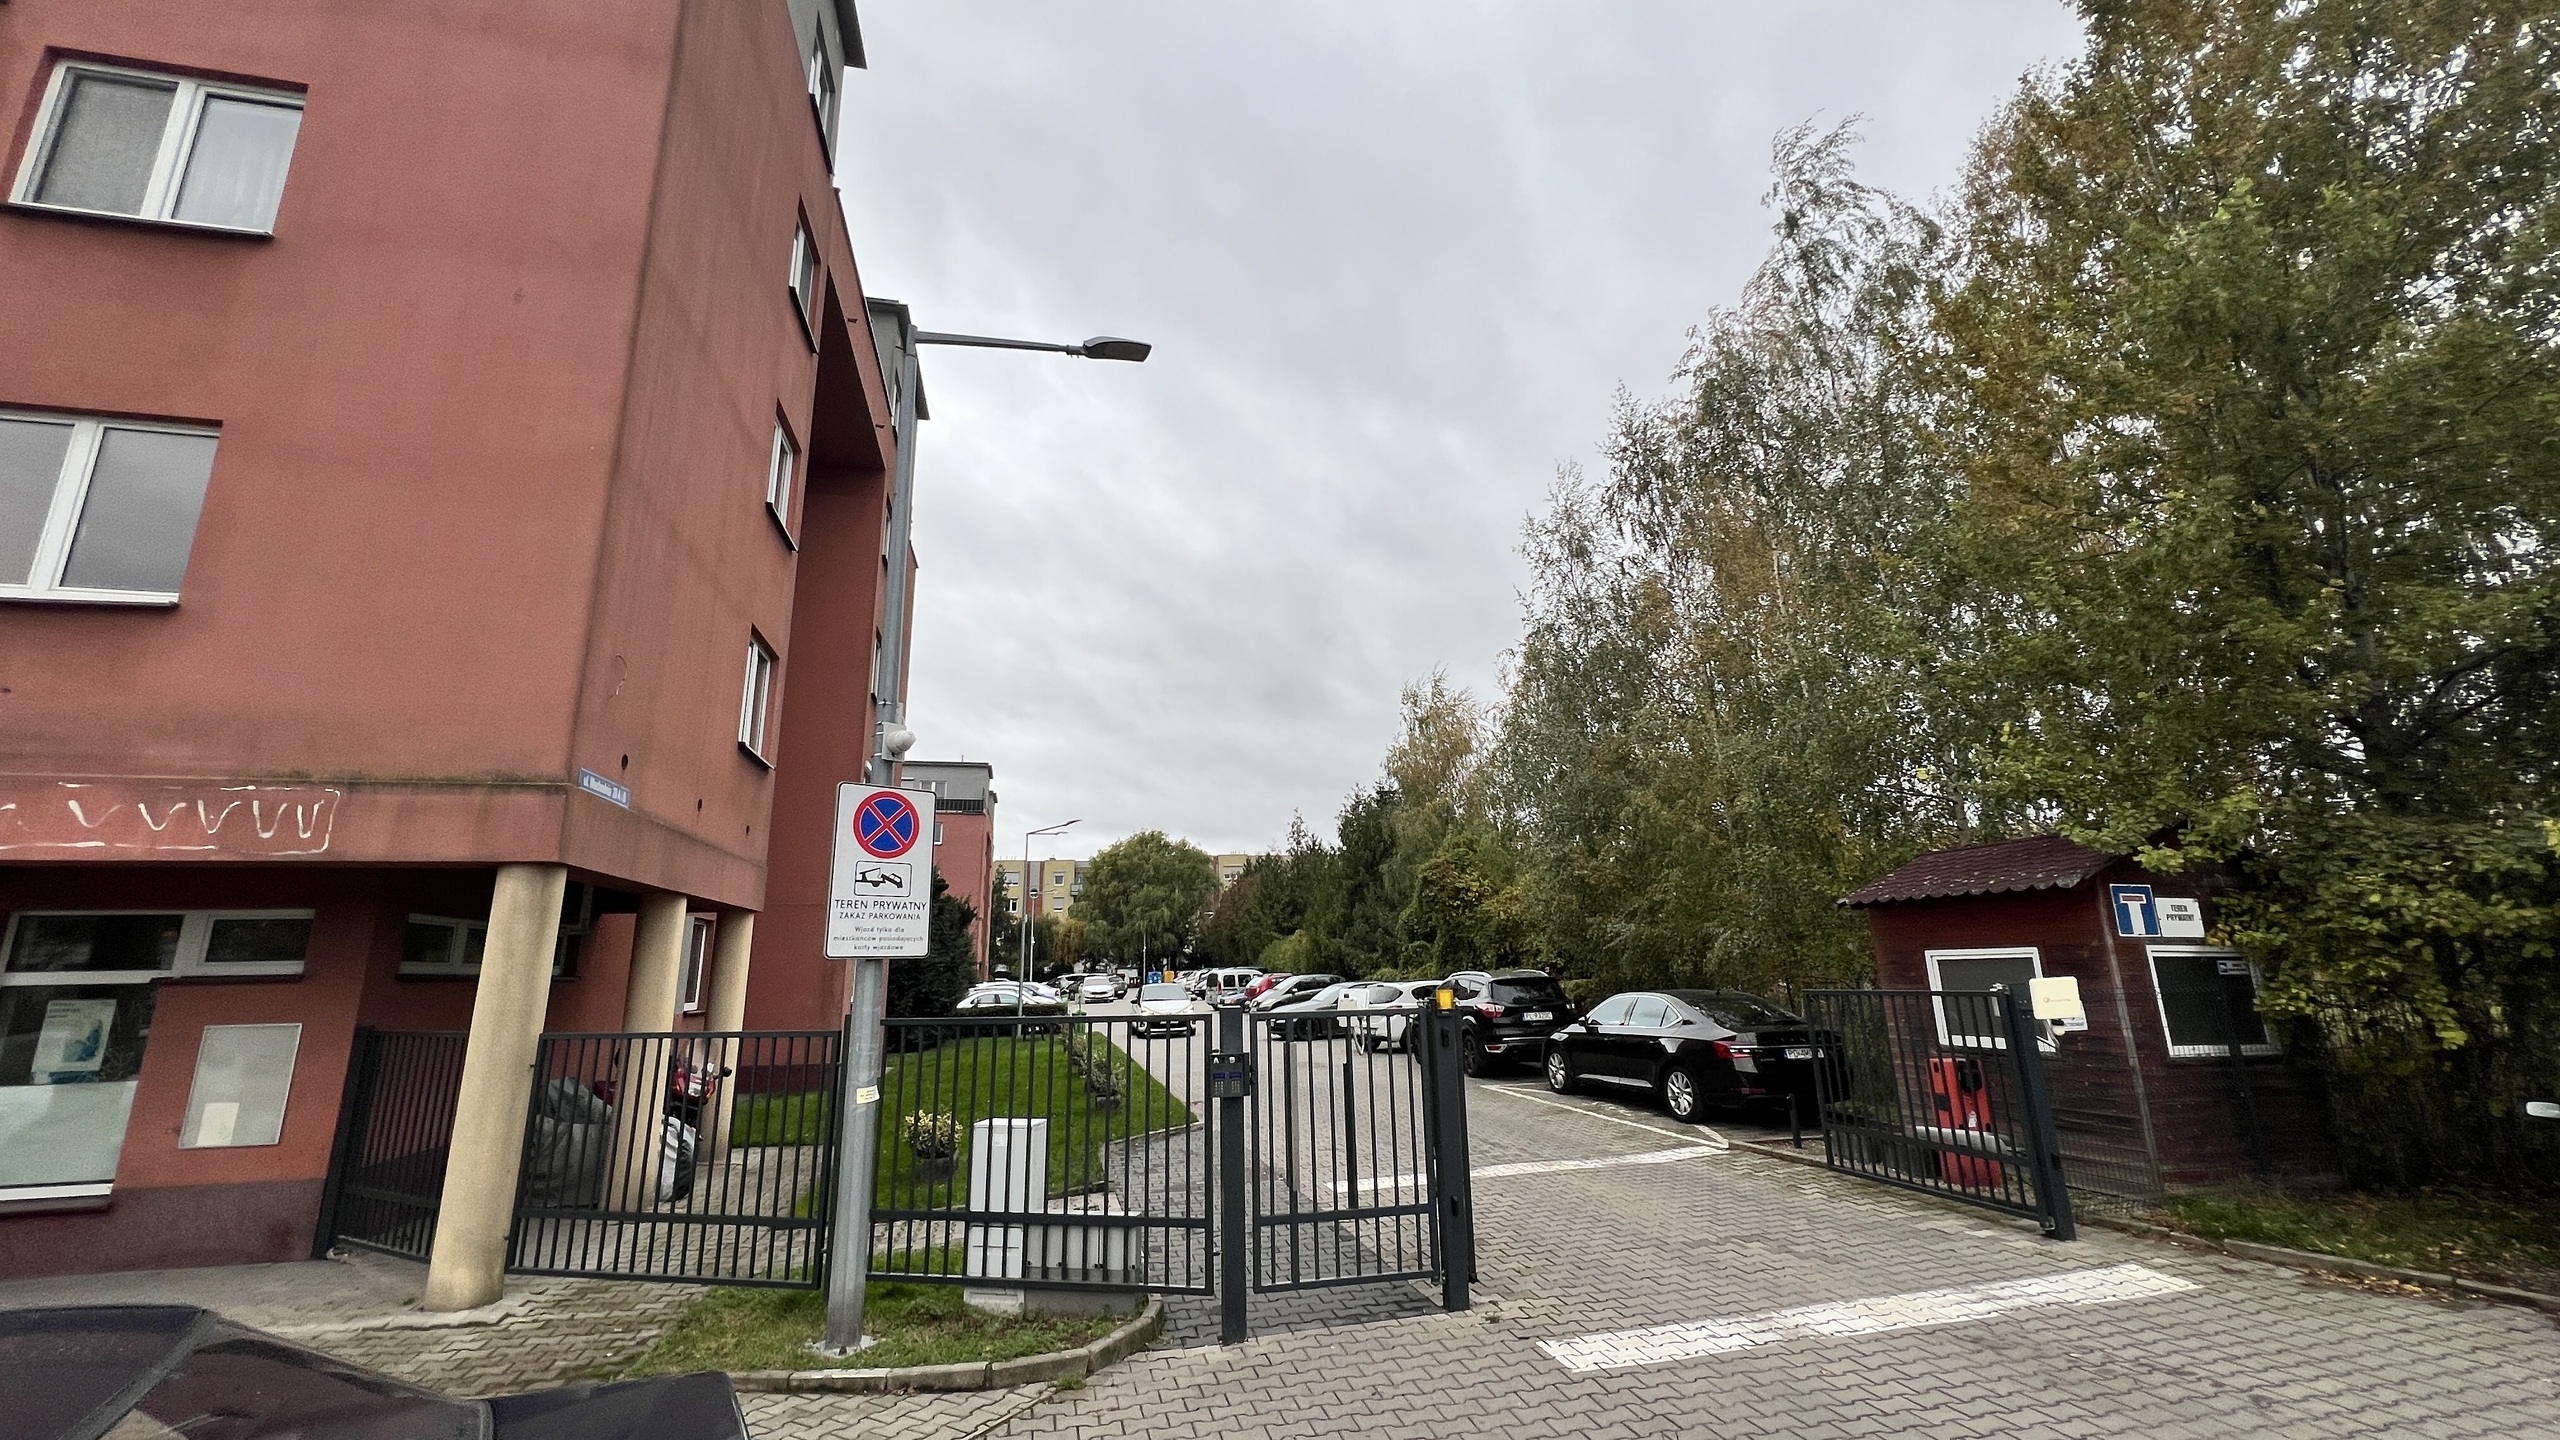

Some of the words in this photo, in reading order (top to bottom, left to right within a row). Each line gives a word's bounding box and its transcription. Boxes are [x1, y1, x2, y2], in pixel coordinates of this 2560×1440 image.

[834, 899, 868, 909] TEREN
[873, 900, 927, 911] PRYWATNY
[839, 911, 866, 919] ZAKAZ
[868, 912, 921, 920] PARKOWANIA
[854, 926, 875, 934] Wjazd
